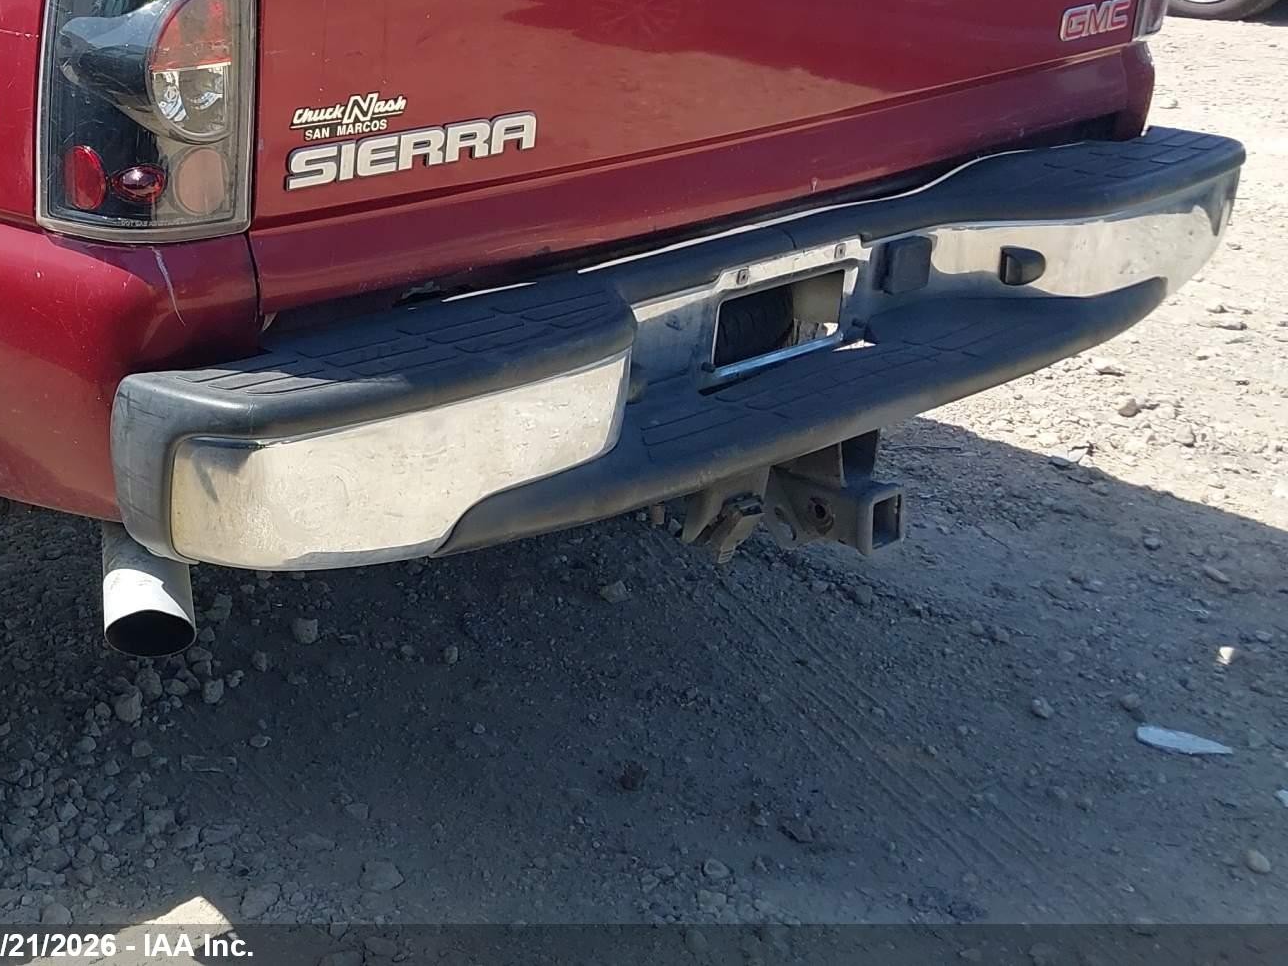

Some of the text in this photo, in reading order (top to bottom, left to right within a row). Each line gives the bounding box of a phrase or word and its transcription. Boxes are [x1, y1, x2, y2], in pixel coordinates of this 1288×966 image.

[291, 91, 408, 126] Chuck Nash
[304, 118, 388, 141] SAN MARCOS
[286, 112, 538, 191] SIERRA
